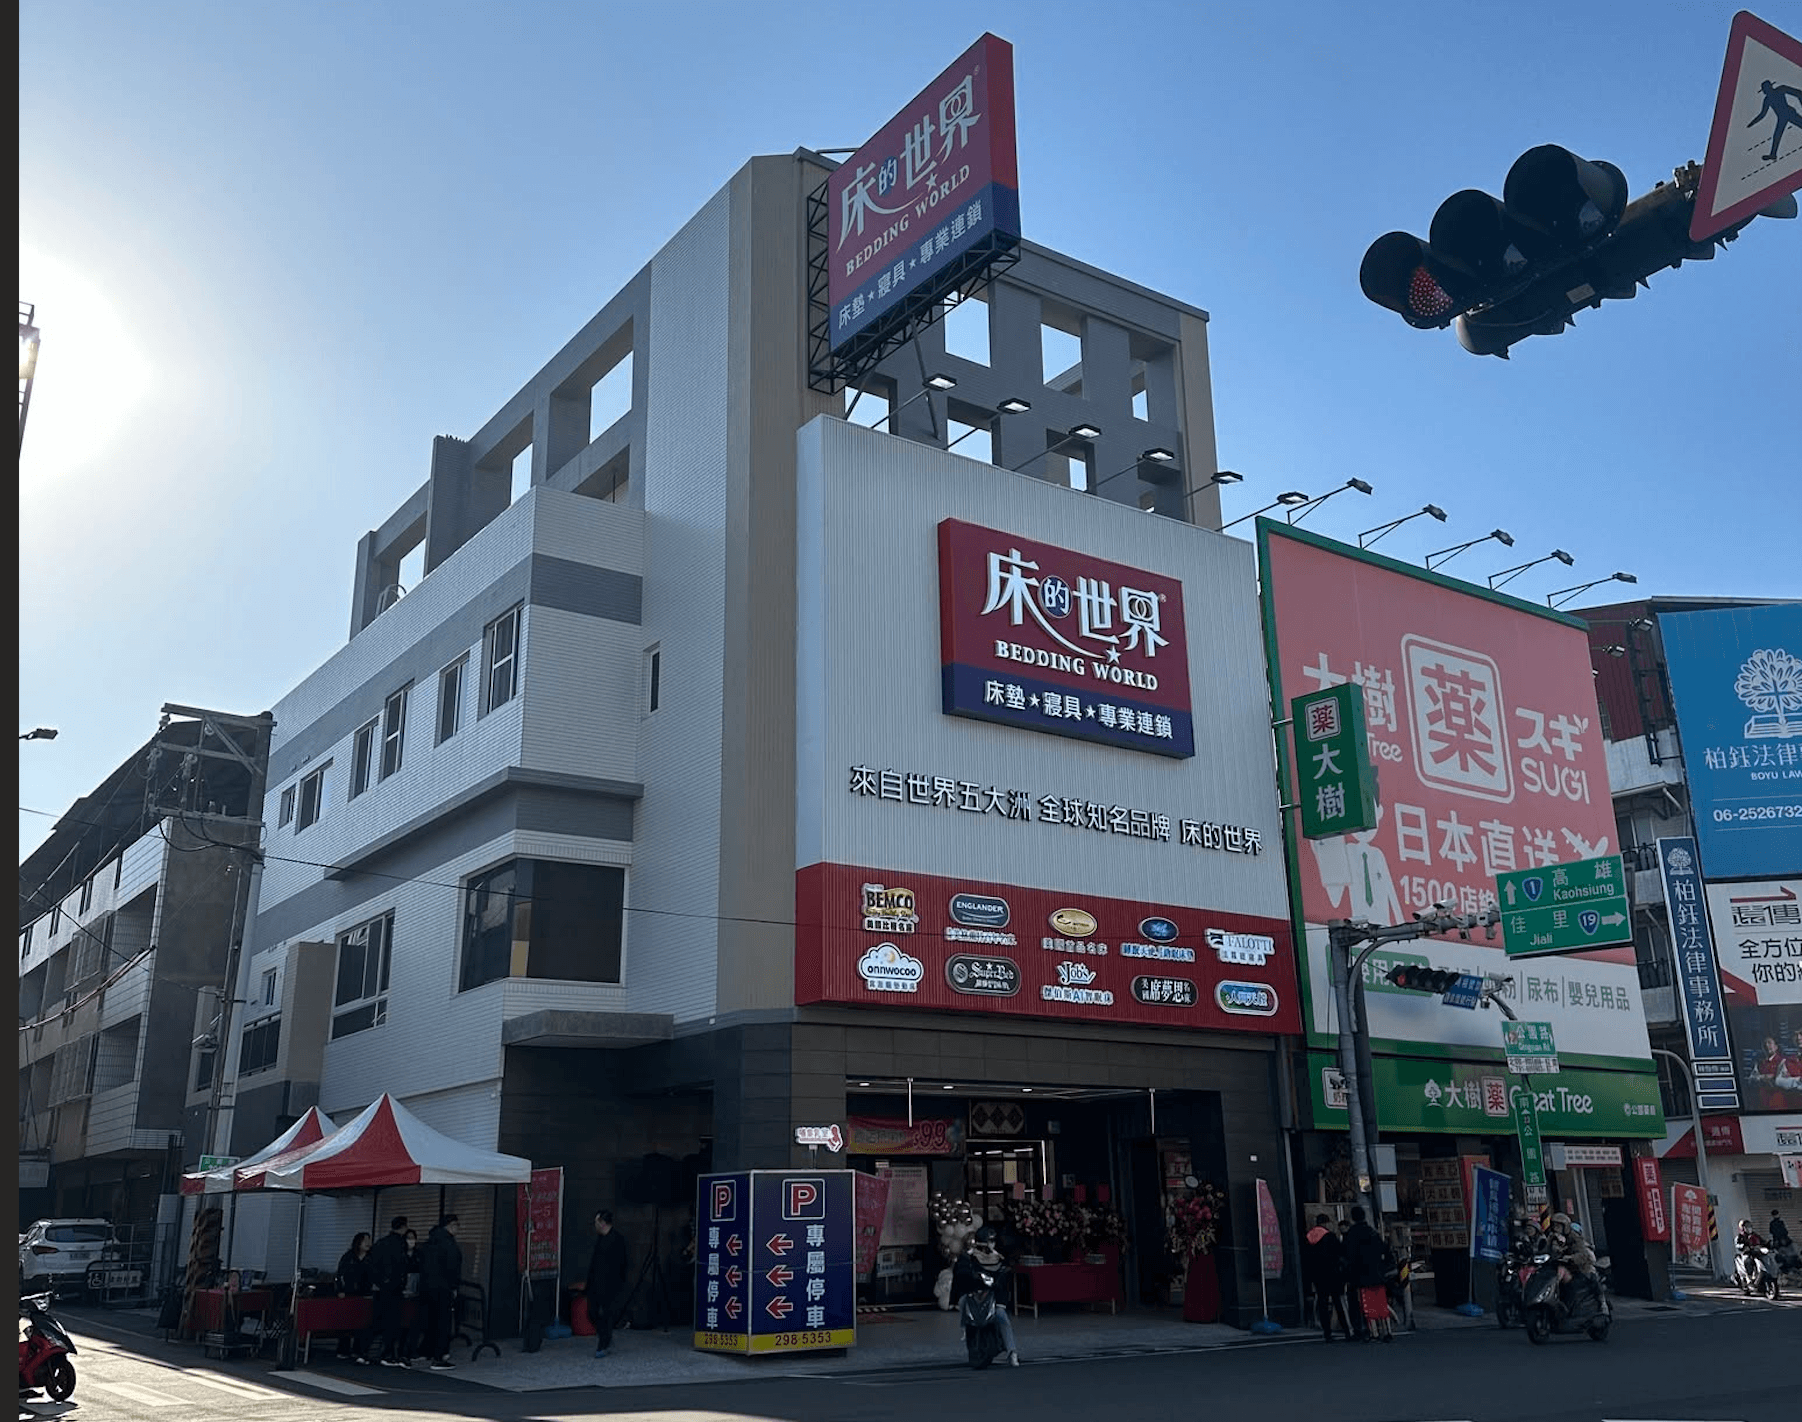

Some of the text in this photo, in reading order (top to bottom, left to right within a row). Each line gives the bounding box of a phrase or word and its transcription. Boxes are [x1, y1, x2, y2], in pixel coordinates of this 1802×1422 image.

[836, 73, 982, 254] 床的世界
[845, 164, 971, 277] BEDDING WORLD
[838, 297, 866, 330] 床墊
[920, 199, 983, 265] 專業連鎖
[980, 548, 1170, 658] 床的世界
[994, 639, 1159, 691] BEDDING WORLD
[984, 680, 1174, 740] 床墊 寢具 專業連鎖
[1515, 706, 1587, 762] スギ
[1703, 742, 1802, 771] 柏鈺法律
[1312, 743, 1346, 822] 大樹
[1521, 757, 1590, 805] SUGI
[1751, 770, 1779, 781] BOYU
[850, 764, 1263, 857] 來自世界五大洲 全球知名品牌 床的世界
[866, 891, 913, 910] BEMCO
[956, 901, 1004, 914] ENGLANDER
[1553, 884, 1615, 901] Kaohsiung
[1582, 914, 1597, 927] 19
[1530, 932, 1553, 946] Jiali
[1673, 879, 1719, 1049] 柏鈺法律事務所
[1752, 962, 1802, 984] 你的
[1526, 976, 1560, 1004] 尿布
[1567, 981, 1631, 1012] 嬰兒用品
[1445, 1079, 1482, 1110] 大樹
[1556, 1086, 1594, 1114] Tree
[714, 1185, 732, 1218] P
[790, 1183, 818, 1217] P
[775, 1331, 832, 1346] 298 5353
